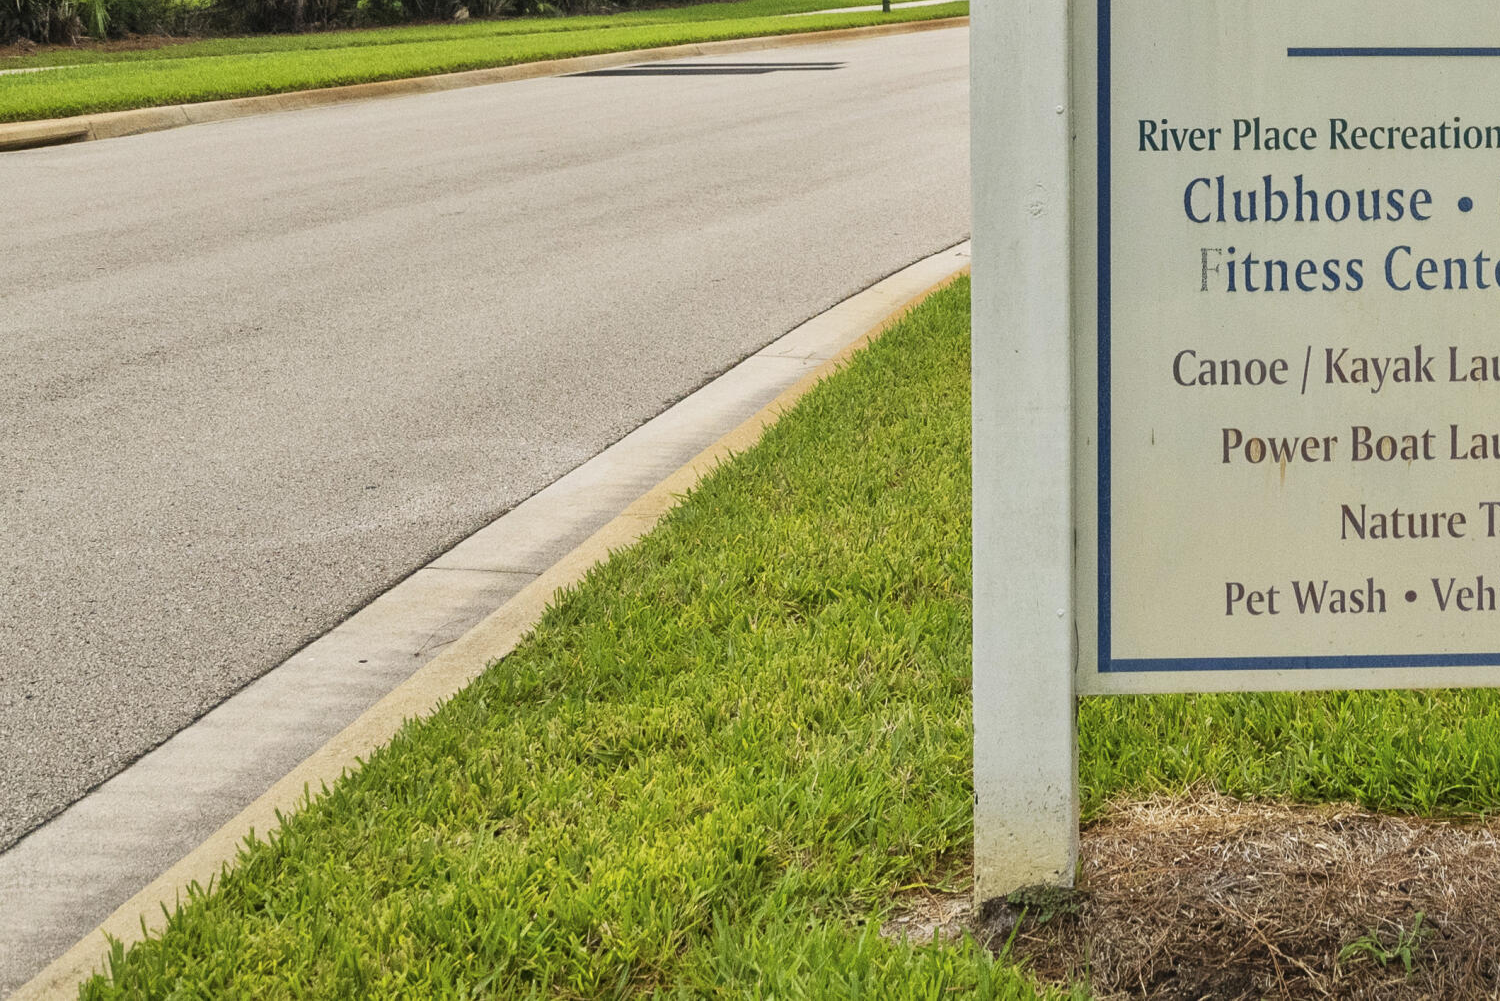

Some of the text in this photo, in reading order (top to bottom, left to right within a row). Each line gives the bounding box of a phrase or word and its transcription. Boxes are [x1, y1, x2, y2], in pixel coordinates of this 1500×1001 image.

[1138, 118, 1222, 152] River
[1232, 116, 1318, 151] Place
[1183, 173, 1433, 224] Clubhouse
[1199, 245, 1364, 293] Fitness
[1172, 349, 1289, 387] Canoe
[1324, 344, 1436, 394] Kayak
[1221, 427, 1339, 464] Power
[1351, 425, 1437, 462] Boat
[1340, 503, 1467, 540] Nature
[1225, 582, 1281, 616] Pet
[1291, 577, 1387, 615] Wash
